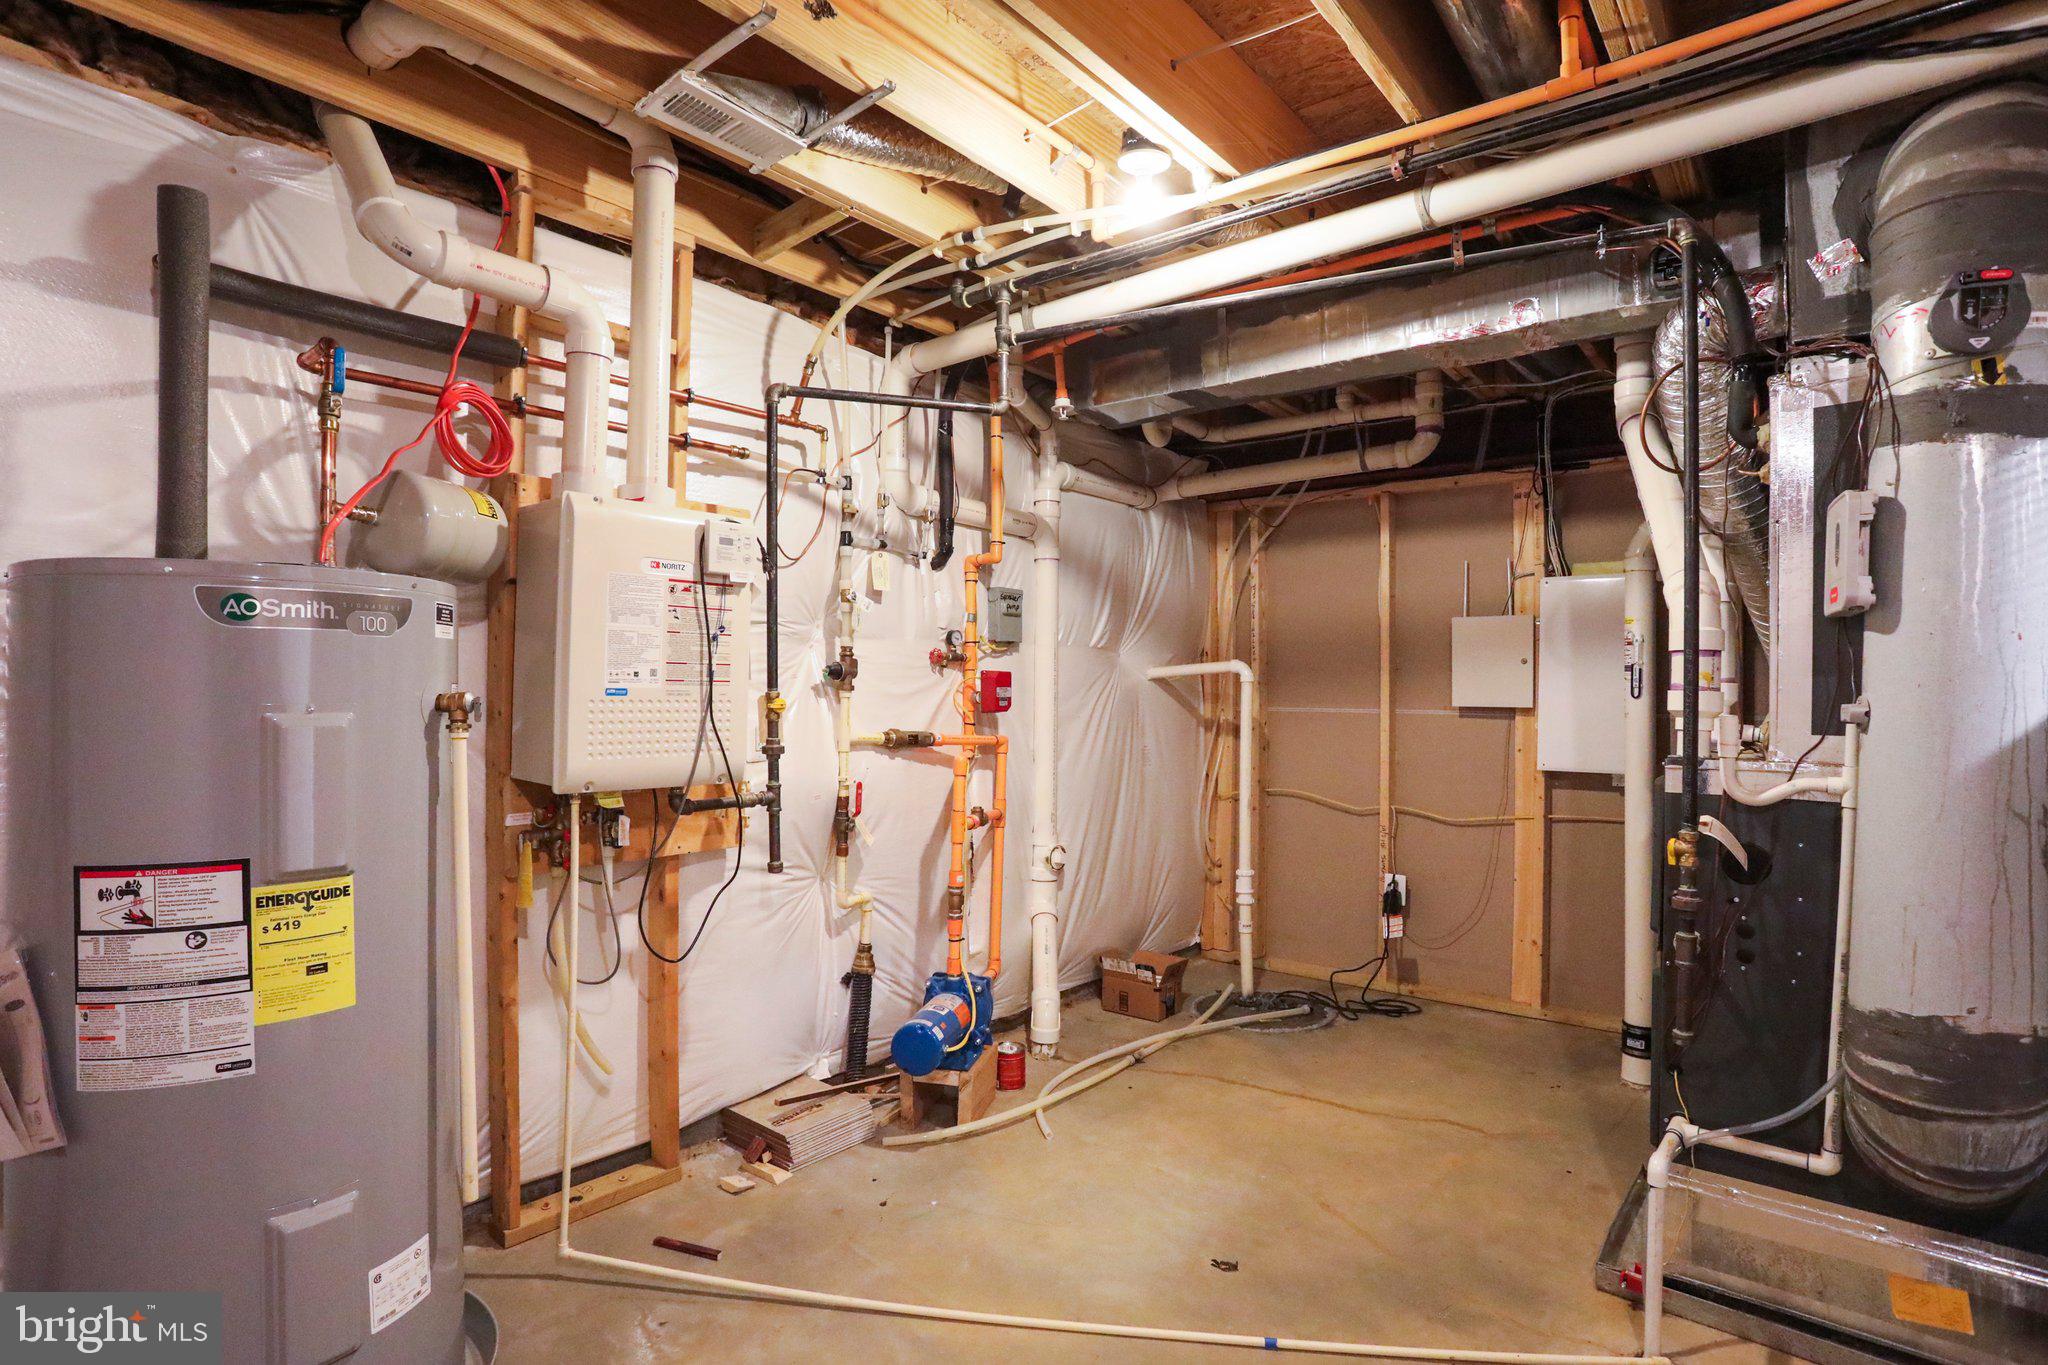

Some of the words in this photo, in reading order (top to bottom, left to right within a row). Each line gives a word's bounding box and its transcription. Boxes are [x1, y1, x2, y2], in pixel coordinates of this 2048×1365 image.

[661, 562, 686, 571] NORITZ
[359, 616, 387, 632] 100
[272, 920, 301, 932] 419
